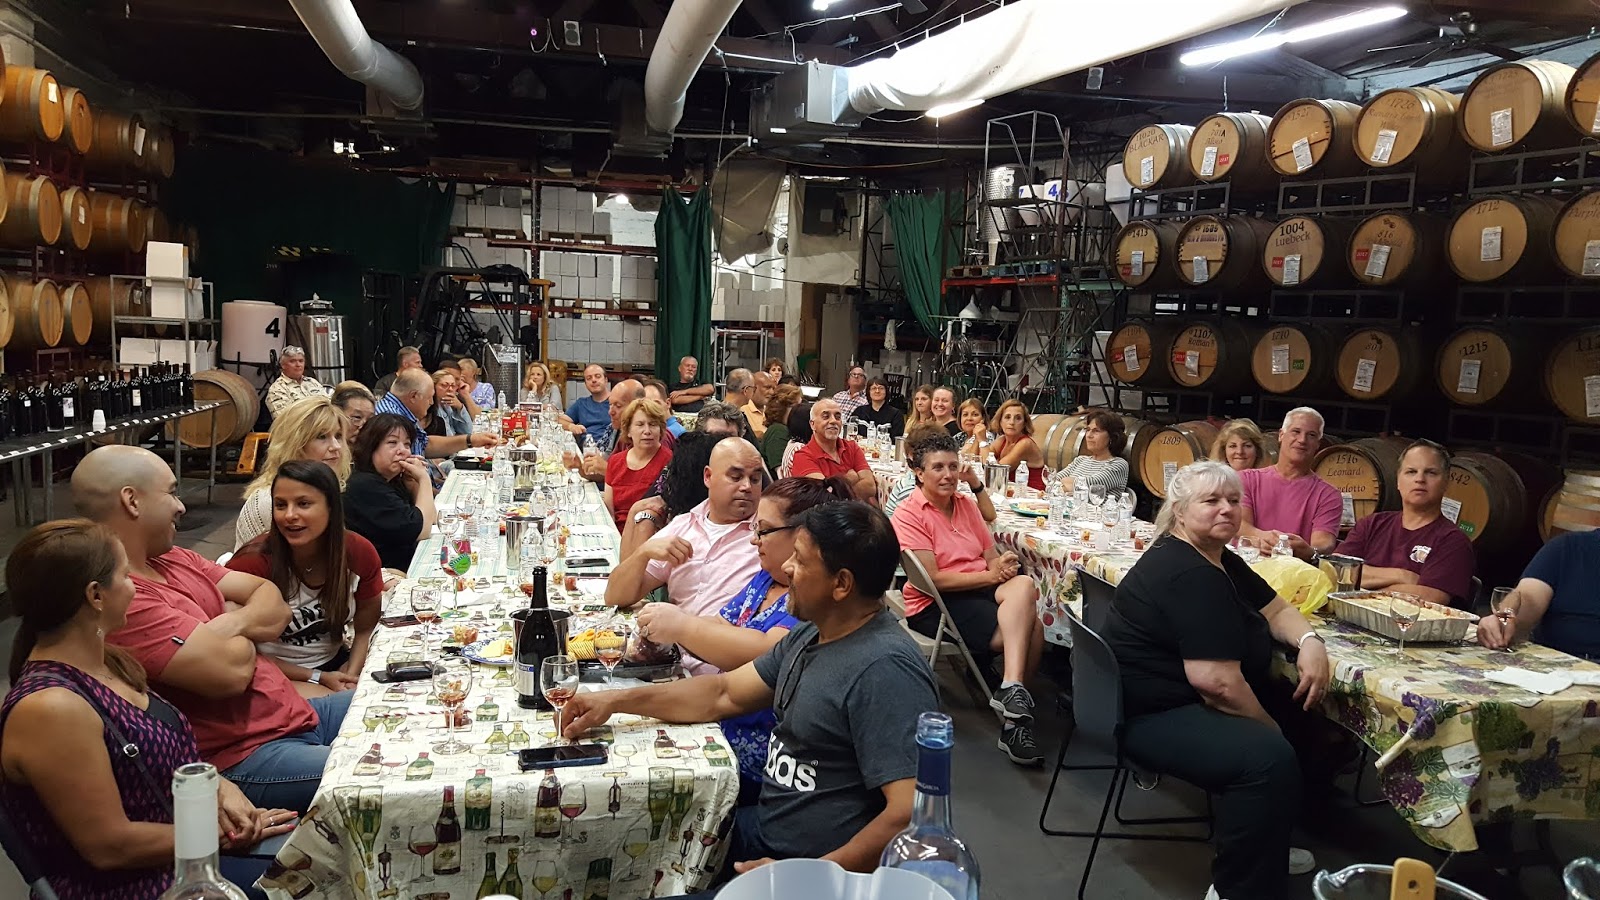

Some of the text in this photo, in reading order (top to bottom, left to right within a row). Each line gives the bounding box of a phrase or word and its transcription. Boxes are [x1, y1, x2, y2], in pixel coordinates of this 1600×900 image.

[1002, 168, 1015, 186] 5
[1279, 221, 1305, 236] 1004
[1275, 231, 1311, 247] Luebeck
[265, 317, 281, 338] 4
[330, 330, 338, 342] 3
[1462, 341, 1488, 356] 1215
[1336, 454, 1358, 464] 1516
